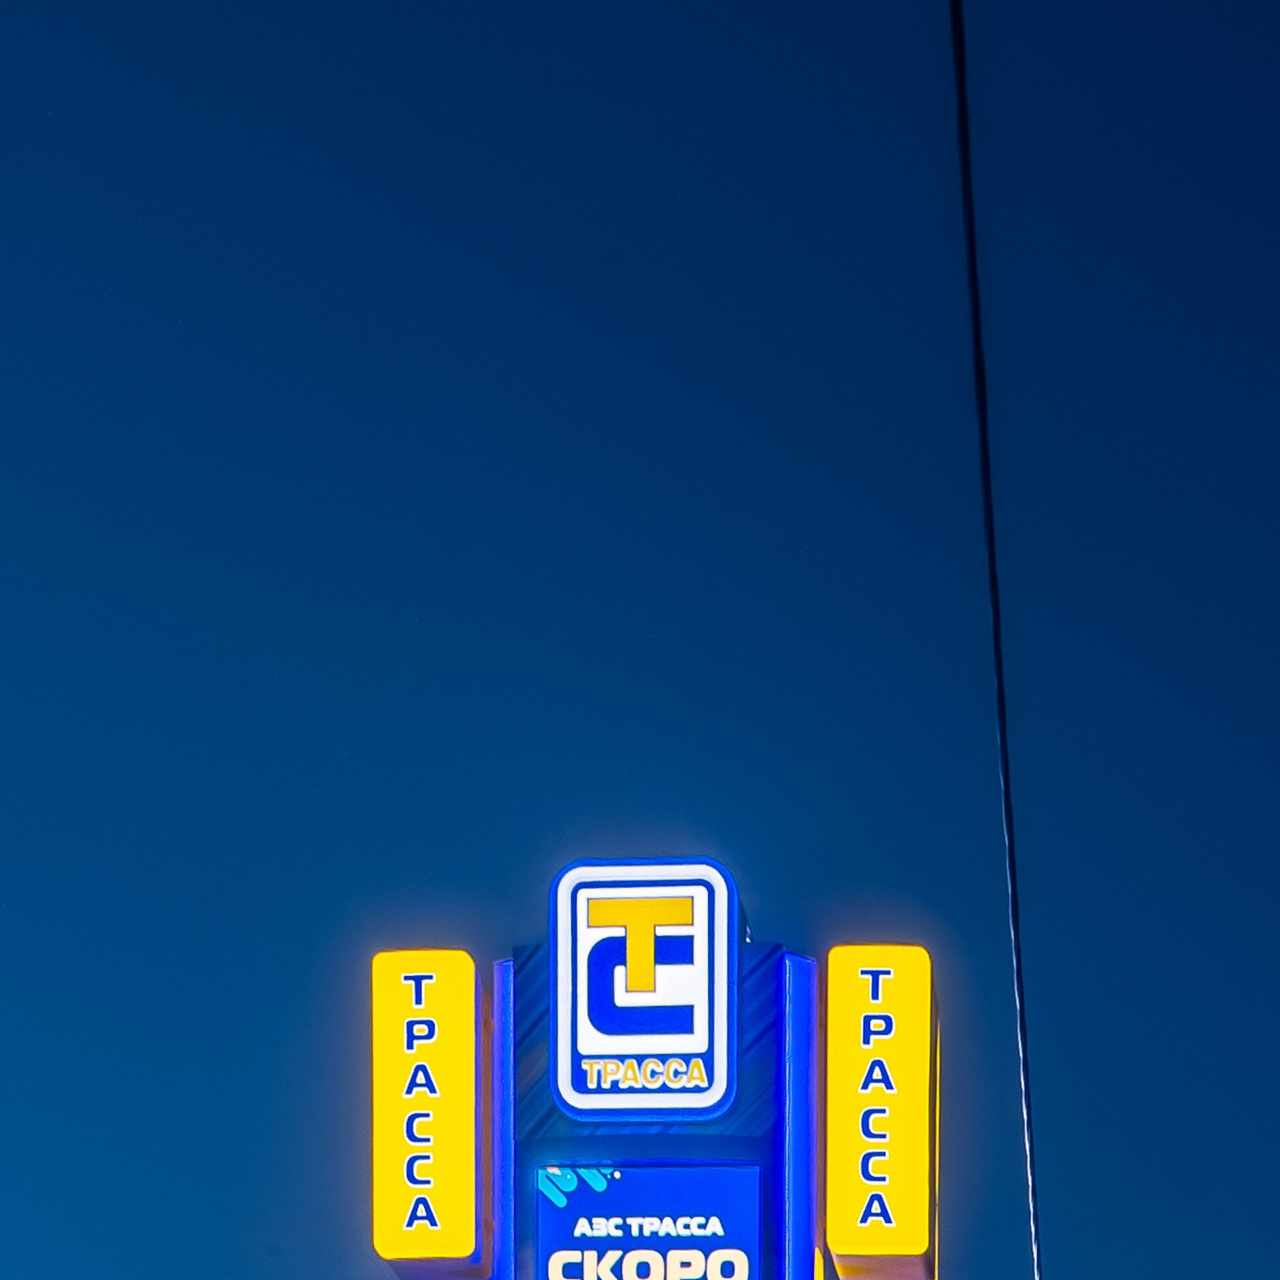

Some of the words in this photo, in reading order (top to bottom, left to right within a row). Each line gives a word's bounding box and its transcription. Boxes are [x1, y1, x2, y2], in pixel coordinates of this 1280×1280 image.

[402, 972, 441, 1231] ТРАССА
[581, 1058, 709, 1090] ТРАССА
[858, 967, 897, 1229] ТРАССА
[573, 1217, 624, 1238] АЗС
[626, 1216, 725, 1237] ТРАССА
